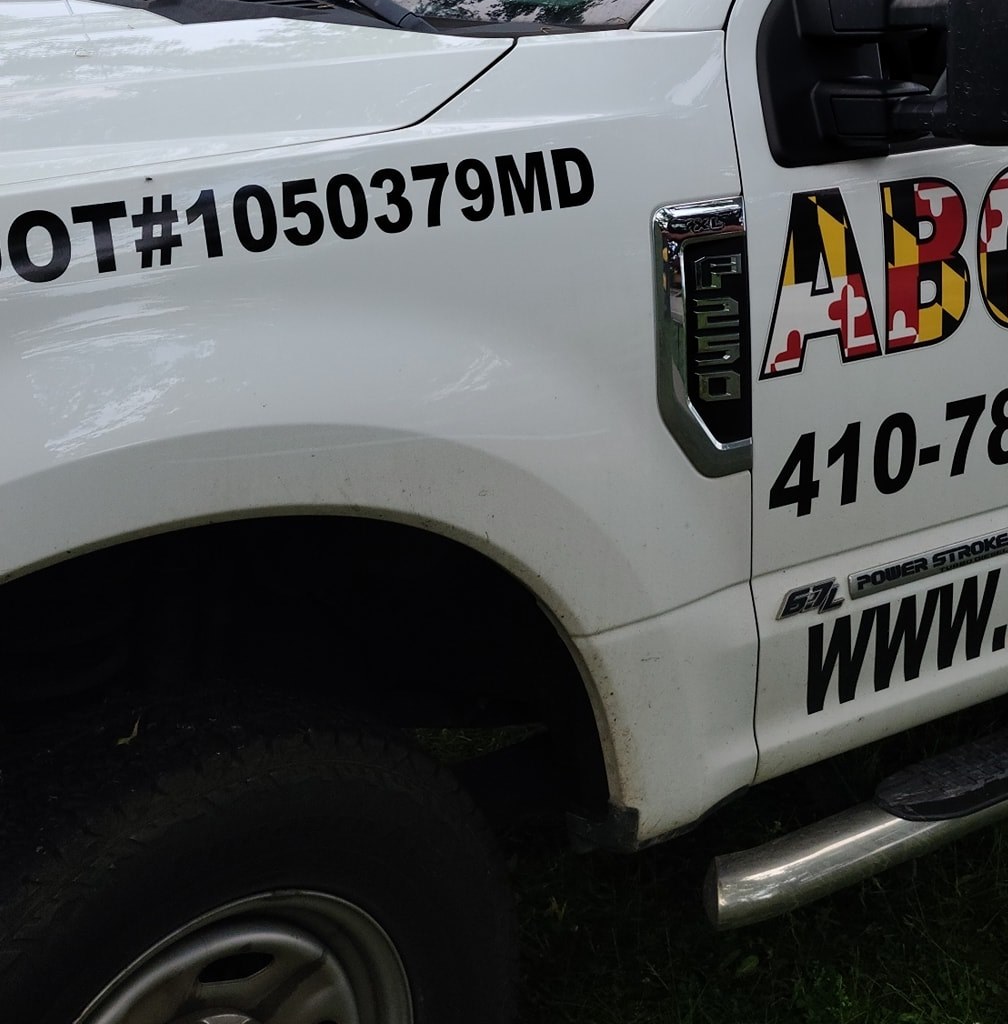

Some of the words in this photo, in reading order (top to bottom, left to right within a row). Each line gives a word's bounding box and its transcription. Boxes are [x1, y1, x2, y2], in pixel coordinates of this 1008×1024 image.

[0, 148, 594, 283] OT#1050379MD
[857, 557, 928, 591] POWER
[932, 533, 1008, 568] STROKE
